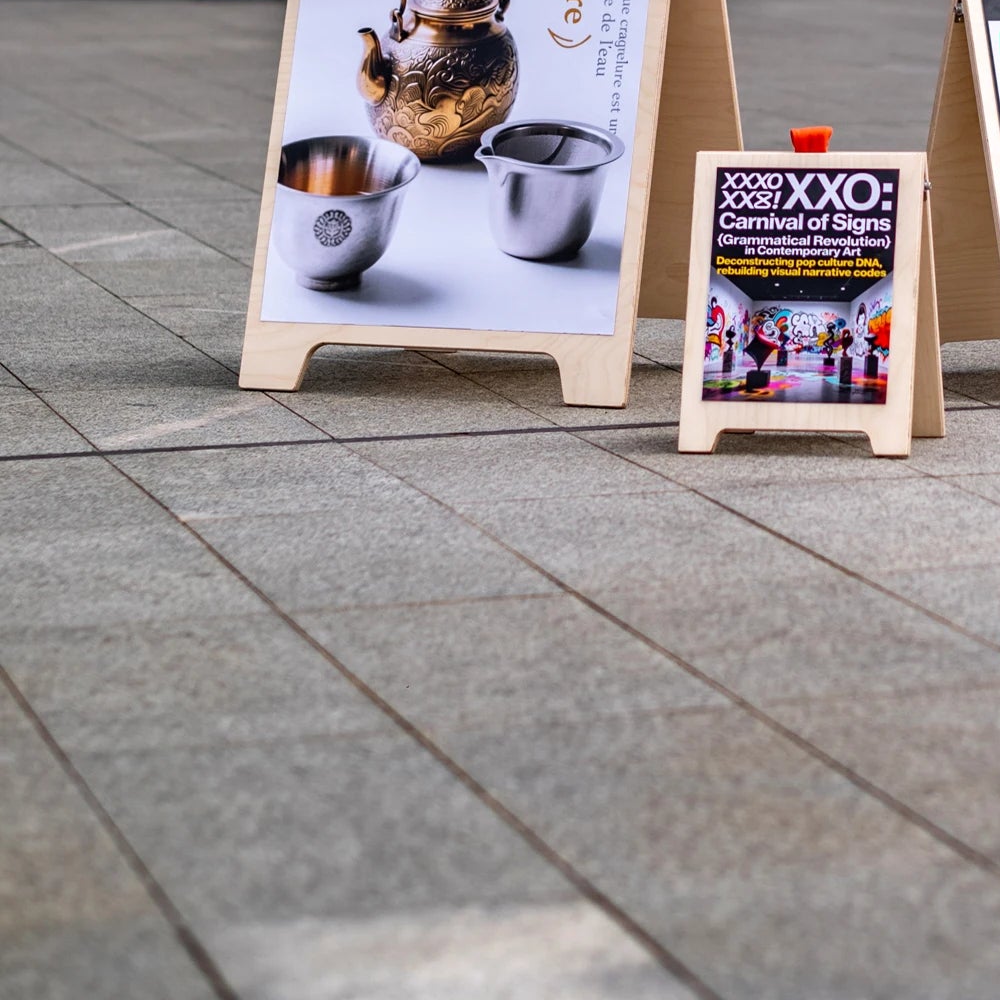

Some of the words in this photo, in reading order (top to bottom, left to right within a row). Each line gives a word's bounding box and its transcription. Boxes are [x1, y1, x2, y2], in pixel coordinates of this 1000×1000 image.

[601, 13, 616, 32] de
[596, 40, 613, 77] l'eau
[611, 92, 621, 113] est
[719, 212, 803, 230] Carnival
[807, 213, 829, 230] of
[832, 213, 891, 235] Signs
[744, 246, 755, 255] in
[757, 246, 841, 258] Contemporary
[842, 247, 862, 257] Art
[716, 256, 794, 268] Deconstructing
[796, 259, 816, 268] pop
[817, 258, 854, 267] culture
[855, 258, 883, 269] DNA,
[716, 266, 769, 277] rebuilding
[770, 267, 801, 276] visual
[803, 268, 852, 277] narrative
[853, 268, 887, 278] codes
